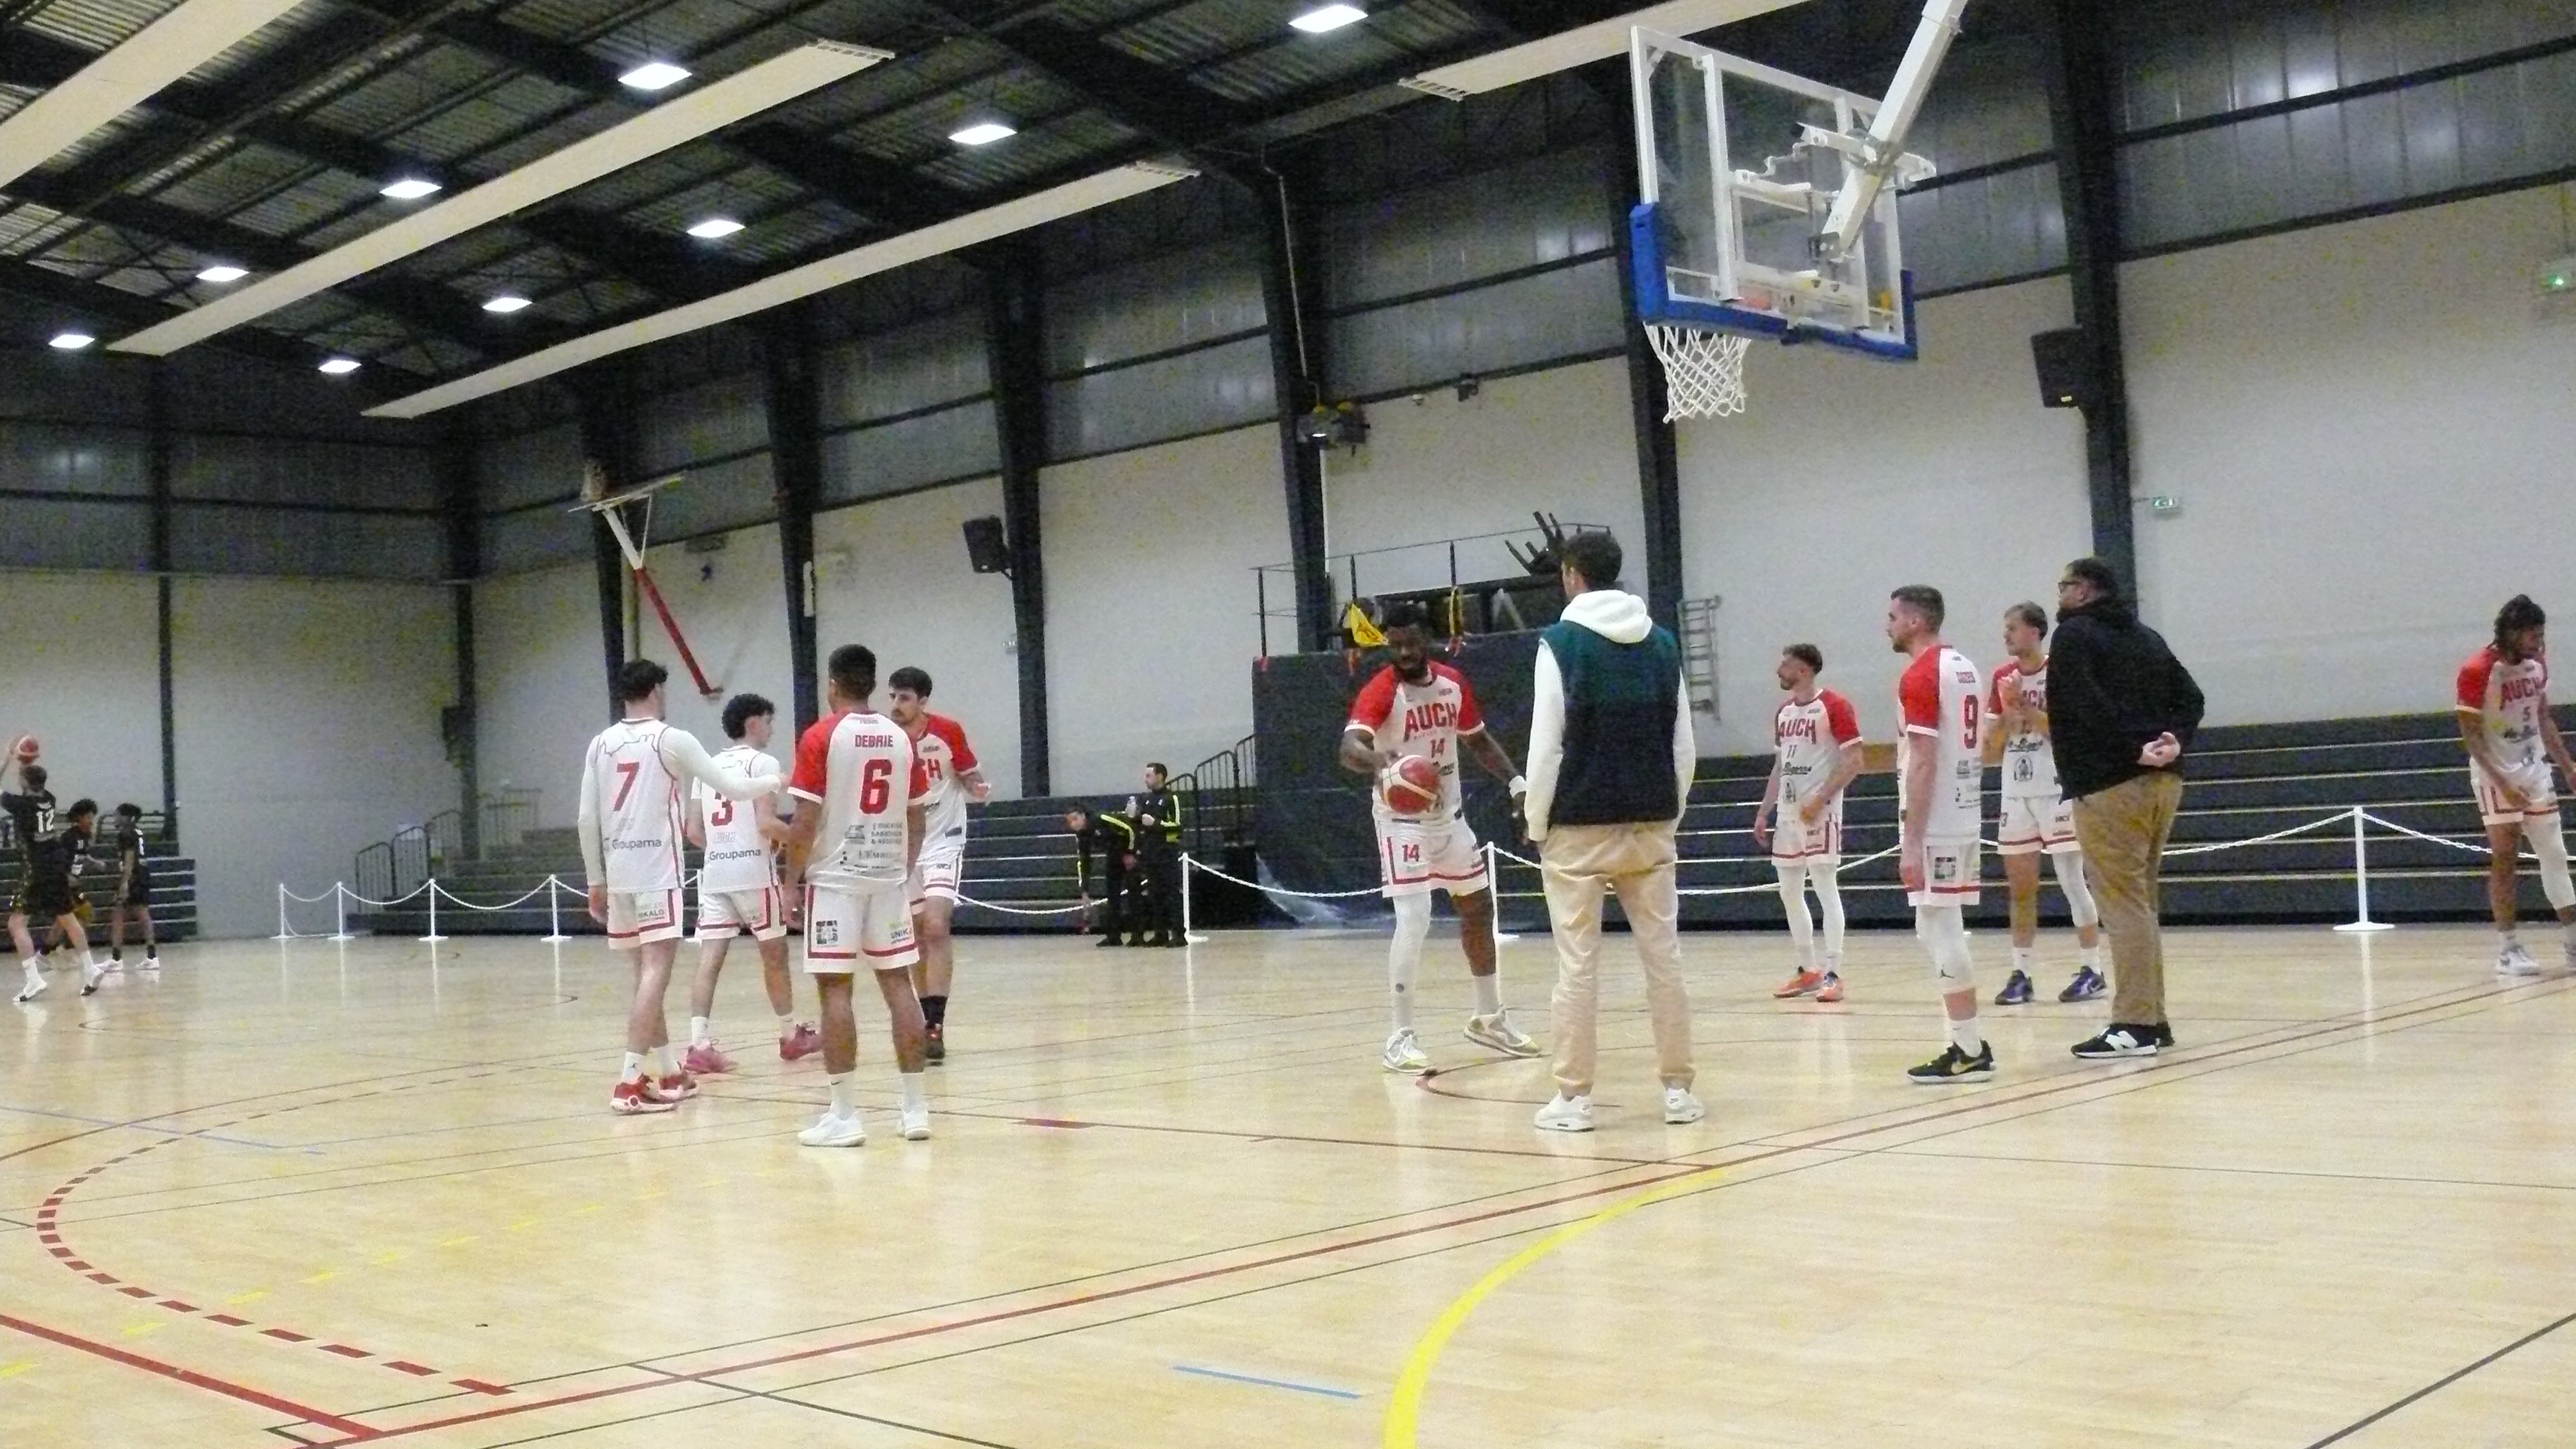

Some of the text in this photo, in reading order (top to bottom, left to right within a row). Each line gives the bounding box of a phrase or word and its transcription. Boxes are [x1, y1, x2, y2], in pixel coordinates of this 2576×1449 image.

[1403, 702, 1458, 743] AUCH
[1778, 718, 1817, 745] AUCH
[1964, 694, 1978, 749] 9
[855, 734, 894, 748] DEBRIE
[1430, 737, 1445, 758] 14
[612, 761, 640, 812] 7
[860, 759, 893, 814] 6
[37, 809, 55, 833] 12
[710, 791, 733, 827] 3
[612, 838, 662, 851] Groupama
[709, 849, 762, 861] Groupama
[1402, 844, 1420, 862] 14
